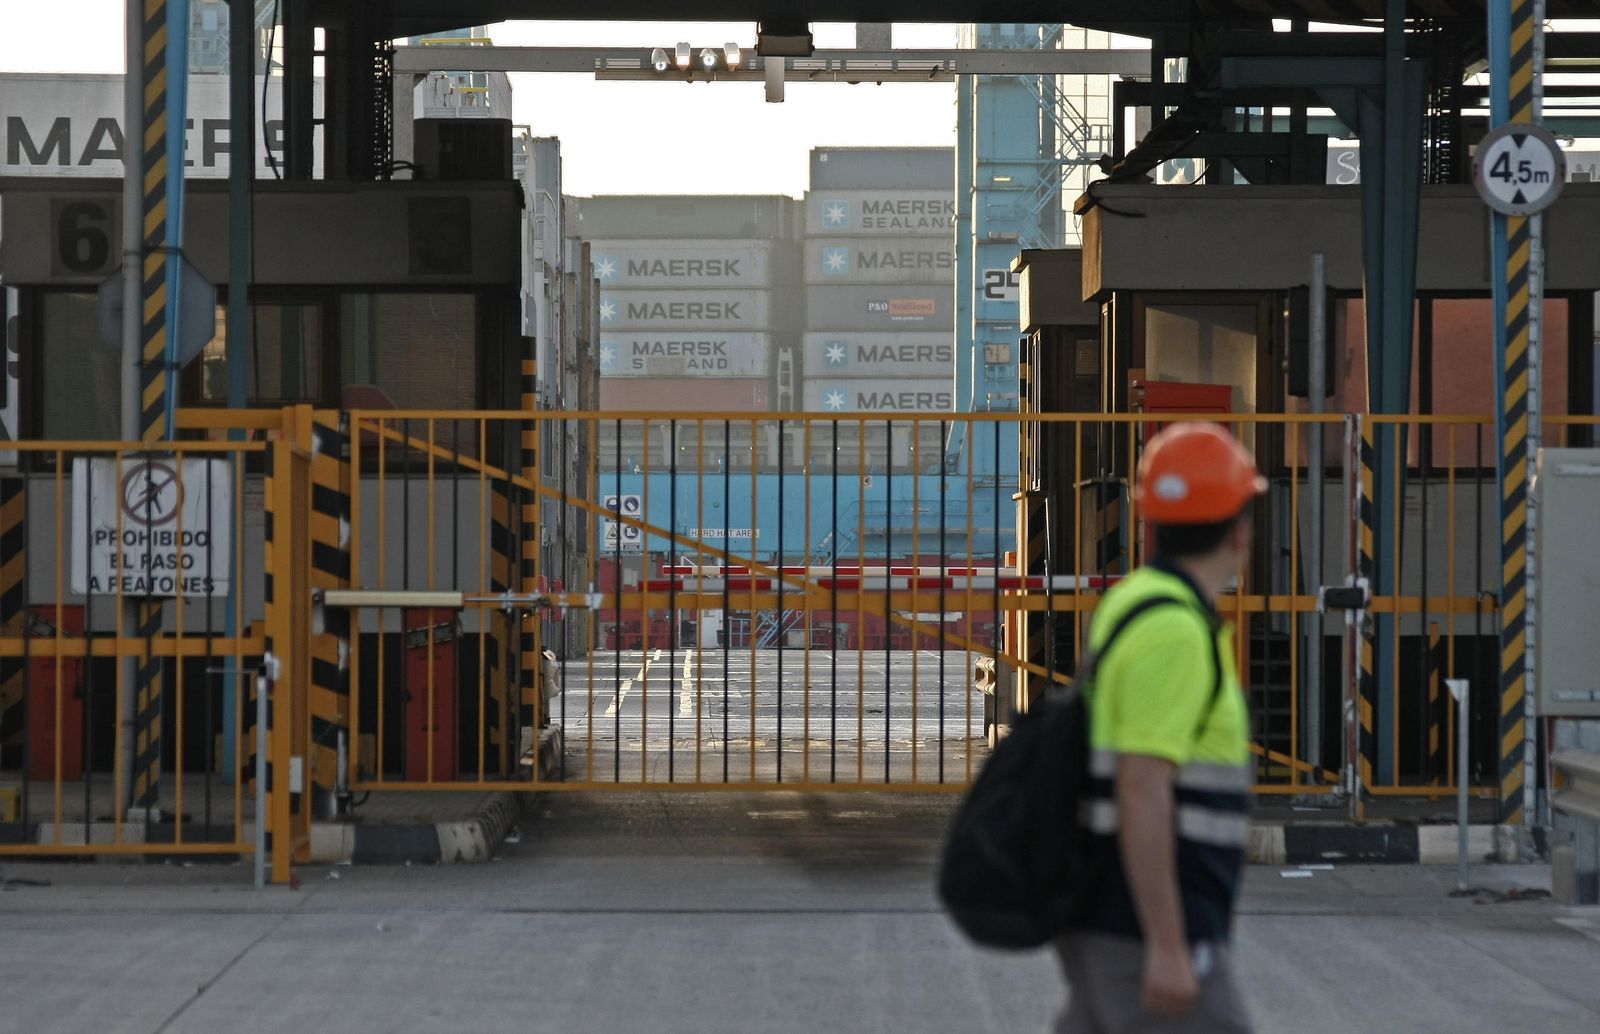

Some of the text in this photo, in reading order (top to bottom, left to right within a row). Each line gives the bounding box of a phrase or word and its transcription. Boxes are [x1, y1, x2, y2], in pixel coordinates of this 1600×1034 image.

[58, 201, 108, 272] 6
[628, 259, 741, 277] MAERSK
[628, 302, 741, 319] MAERSK
[867, 302, 888, 311] P&O
[632, 341, 727, 356] MAERSK
[857, 345, 952, 363] MAERS
[857, 392, 952, 410] MAERS
[691, 529, 715, 537] HRD
[717, 529, 733, 537] HT
